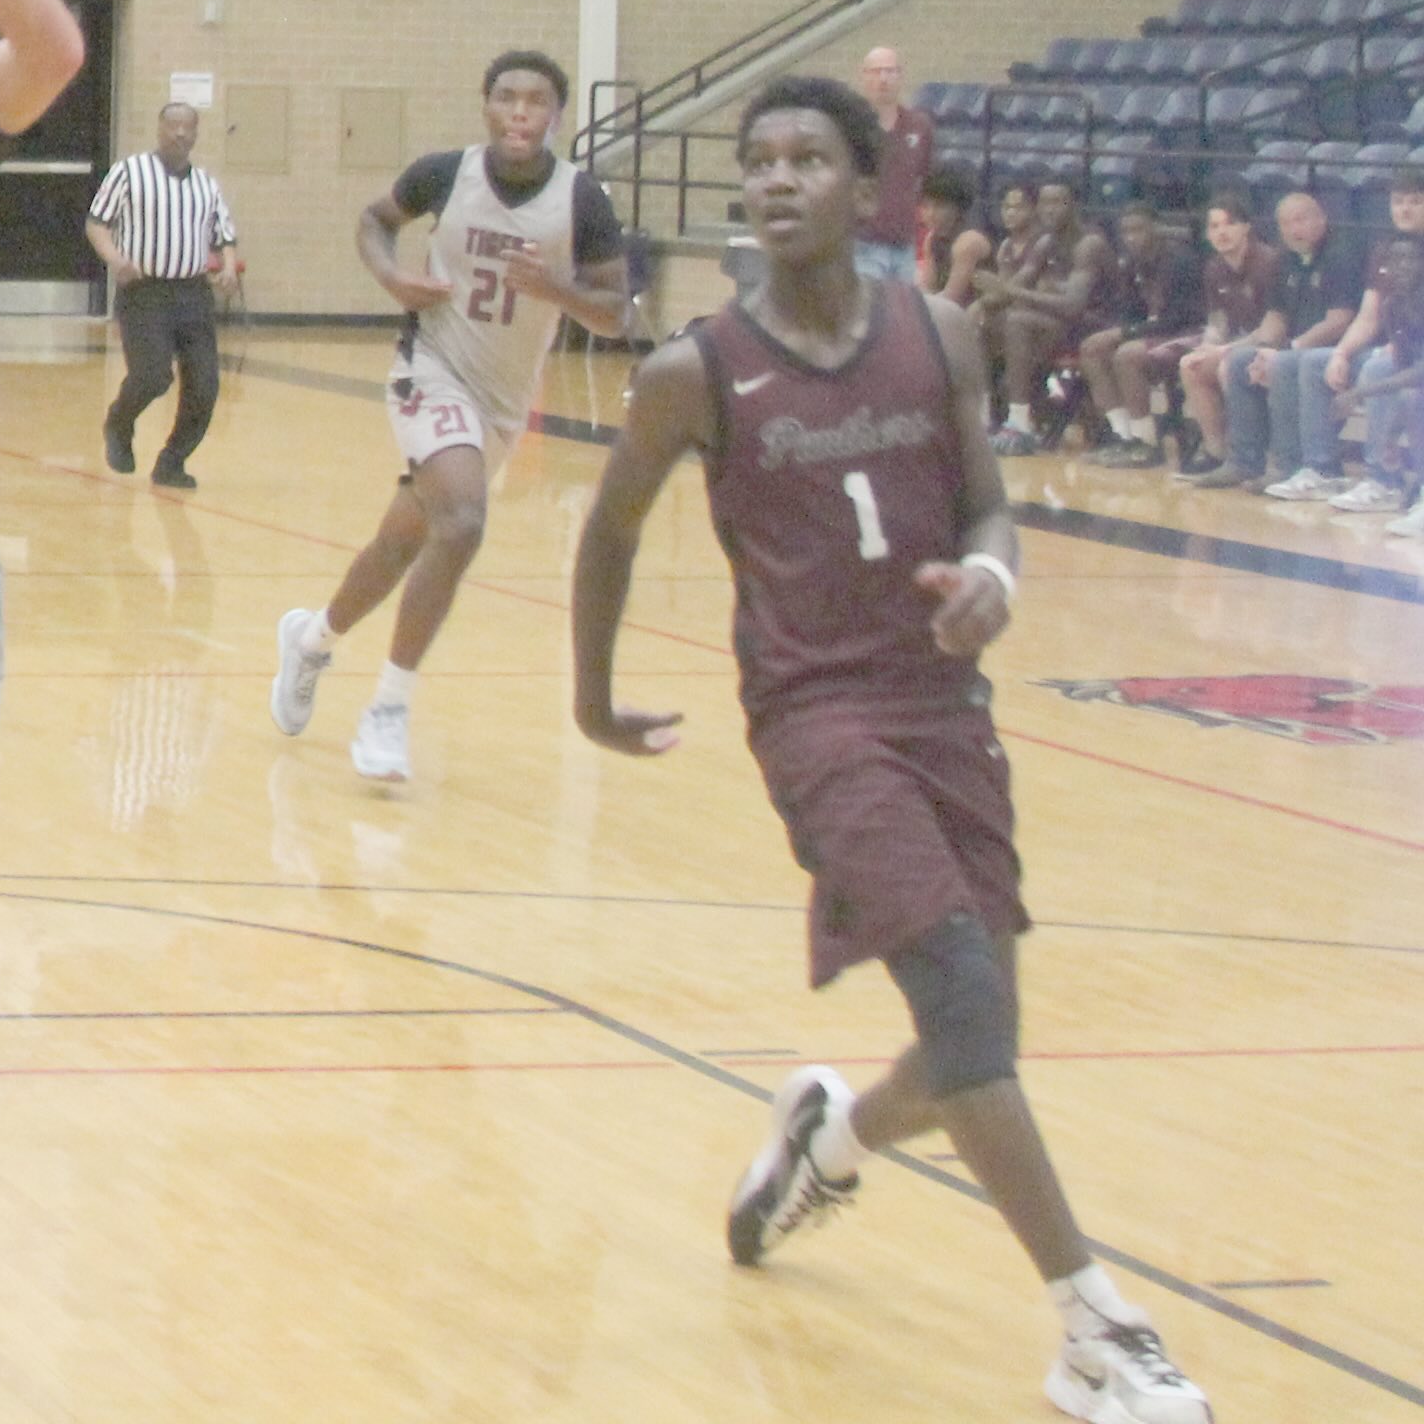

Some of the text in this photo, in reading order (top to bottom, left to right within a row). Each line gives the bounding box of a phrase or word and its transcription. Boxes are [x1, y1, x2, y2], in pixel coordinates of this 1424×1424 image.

[467, 268, 517, 326] 21
[430, 404, 470, 438] 21
[842, 471, 889, 560] 1
